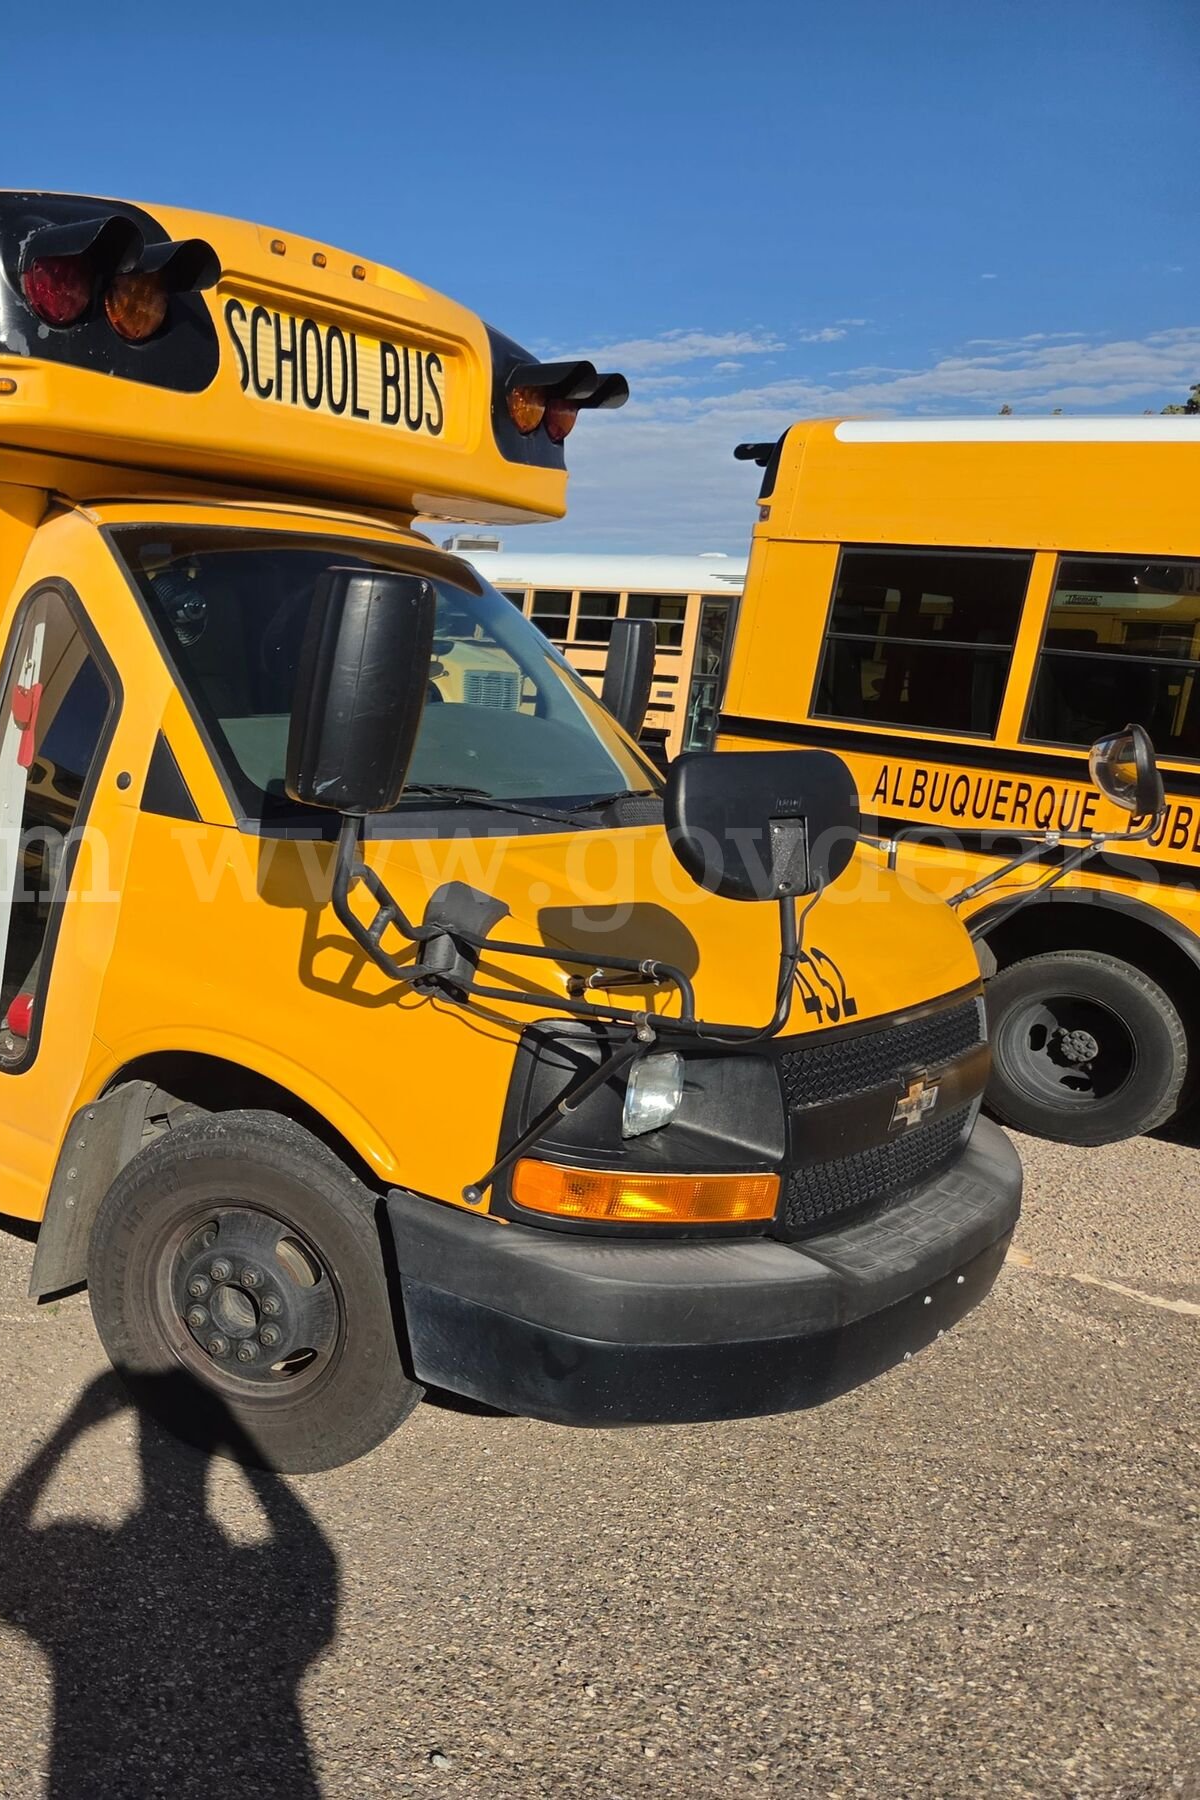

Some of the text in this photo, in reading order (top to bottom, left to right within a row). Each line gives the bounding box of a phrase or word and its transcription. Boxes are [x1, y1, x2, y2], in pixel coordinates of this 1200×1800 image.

[224, 298, 443, 436] SCHOOL BUS
[871, 764, 1100, 833] ALBUQUERQUE
[793, 946, 858, 1025] 432
